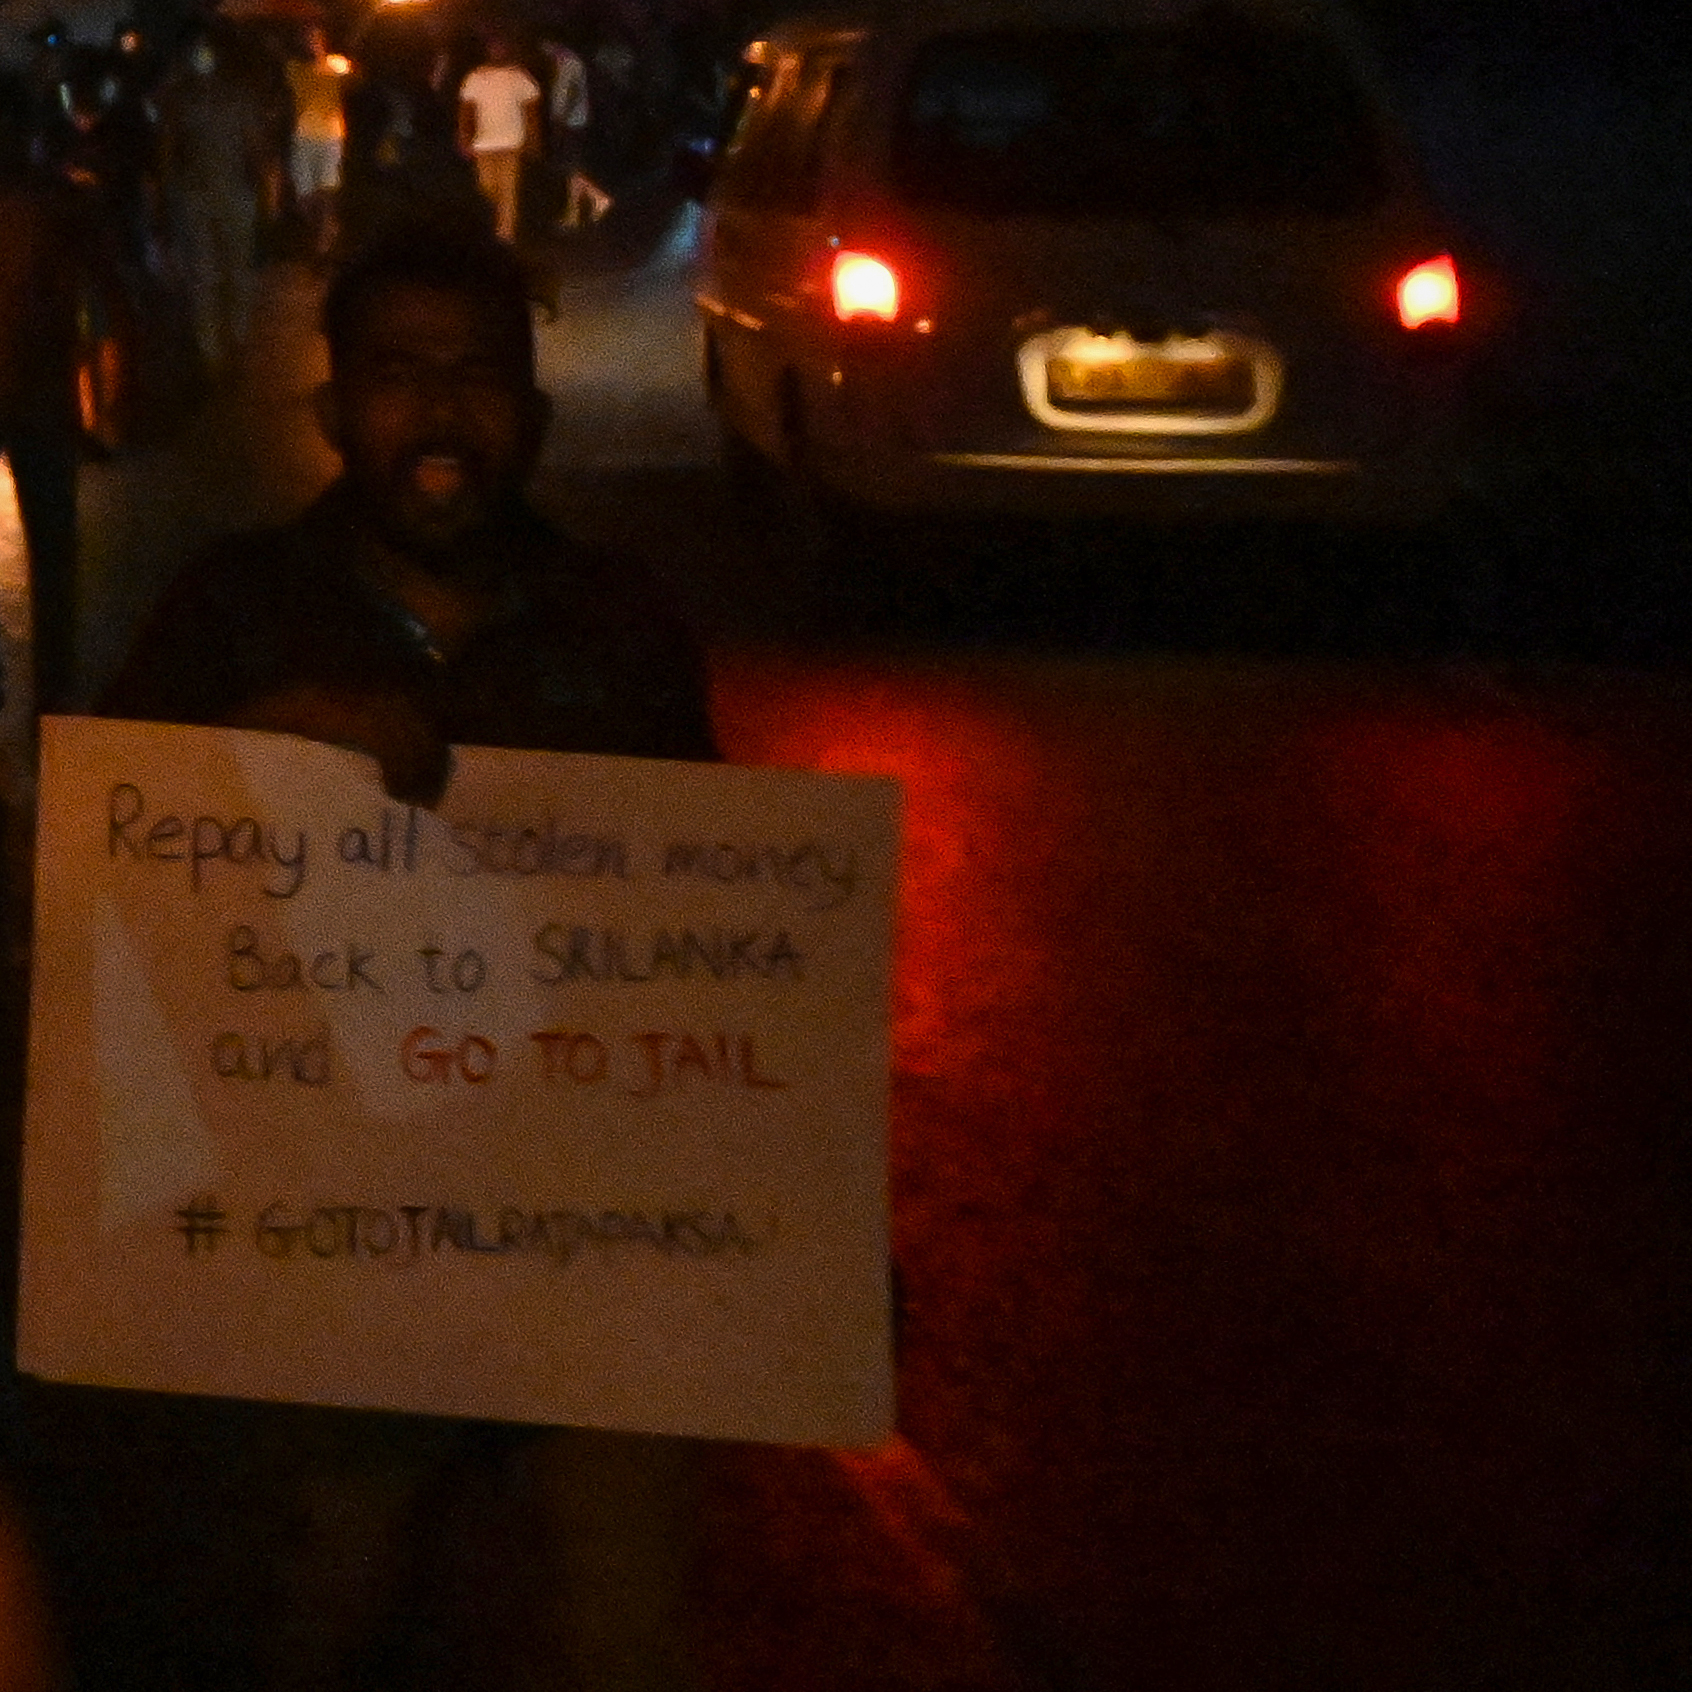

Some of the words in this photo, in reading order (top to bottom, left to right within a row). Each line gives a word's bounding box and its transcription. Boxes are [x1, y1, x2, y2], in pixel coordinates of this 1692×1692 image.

[106, 782, 308, 900] Repay
[337, 804, 419, 874] all
[660, 830, 858, 912] money
[223, 923, 384, 994] Back
[418, 939, 488, 995] to
[210, 1029, 332, 1088] and
[399, 1024, 498, 1086] GO
[529, 1028, 608, 1086] TO
[630, 1029, 790, 1099] JAIL
